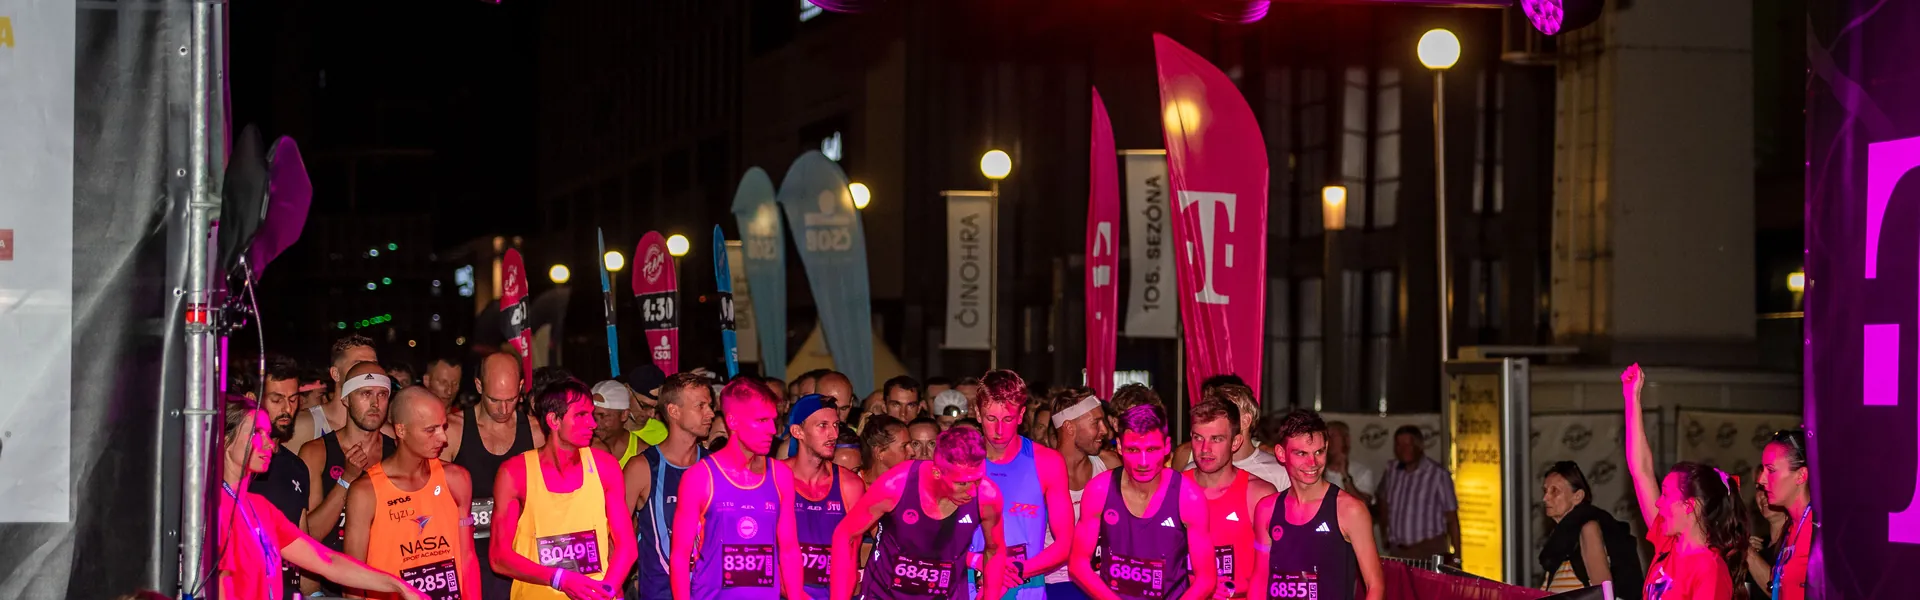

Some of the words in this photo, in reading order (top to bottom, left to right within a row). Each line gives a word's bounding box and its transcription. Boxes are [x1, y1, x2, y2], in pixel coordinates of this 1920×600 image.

[1141, 175, 1163, 260] SEZÓNA
[954, 212, 981, 329] ČINOHRA
[642, 296, 674, 322] 4:30
[400, 535, 450, 558] NASA
[420, 548, 452, 560] ACADEMY
[540, 542, 587, 565] 8049
[723, 555, 766, 571] 8387
[894, 563, 940, 583] 6843
[1109, 563, 1153, 584] 6865
[1270, 581, 1308, 599] 6855
